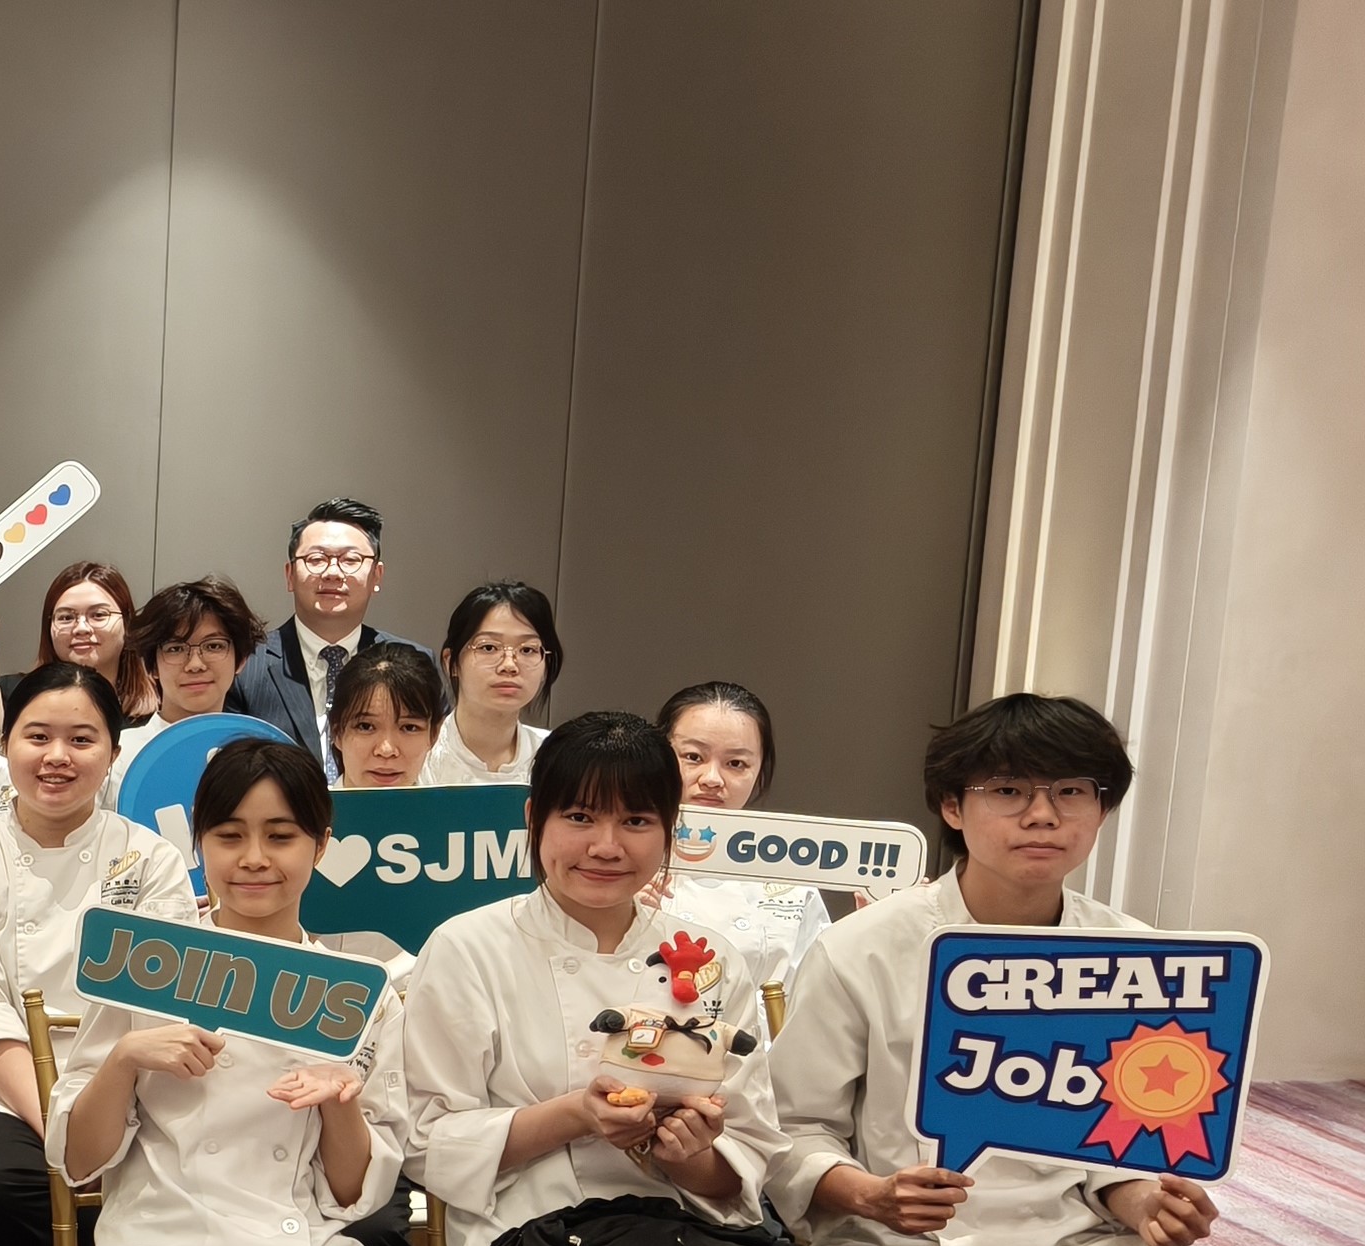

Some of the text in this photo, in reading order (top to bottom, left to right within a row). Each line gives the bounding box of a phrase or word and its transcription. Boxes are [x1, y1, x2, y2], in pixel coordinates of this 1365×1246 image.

[375, 829, 532, 884] SJM
[726, 830, 902, 879] GOOD !!!
[946, 955, 1224, 1012] GREAT
[944, 1036, 1103, 1107] Job
